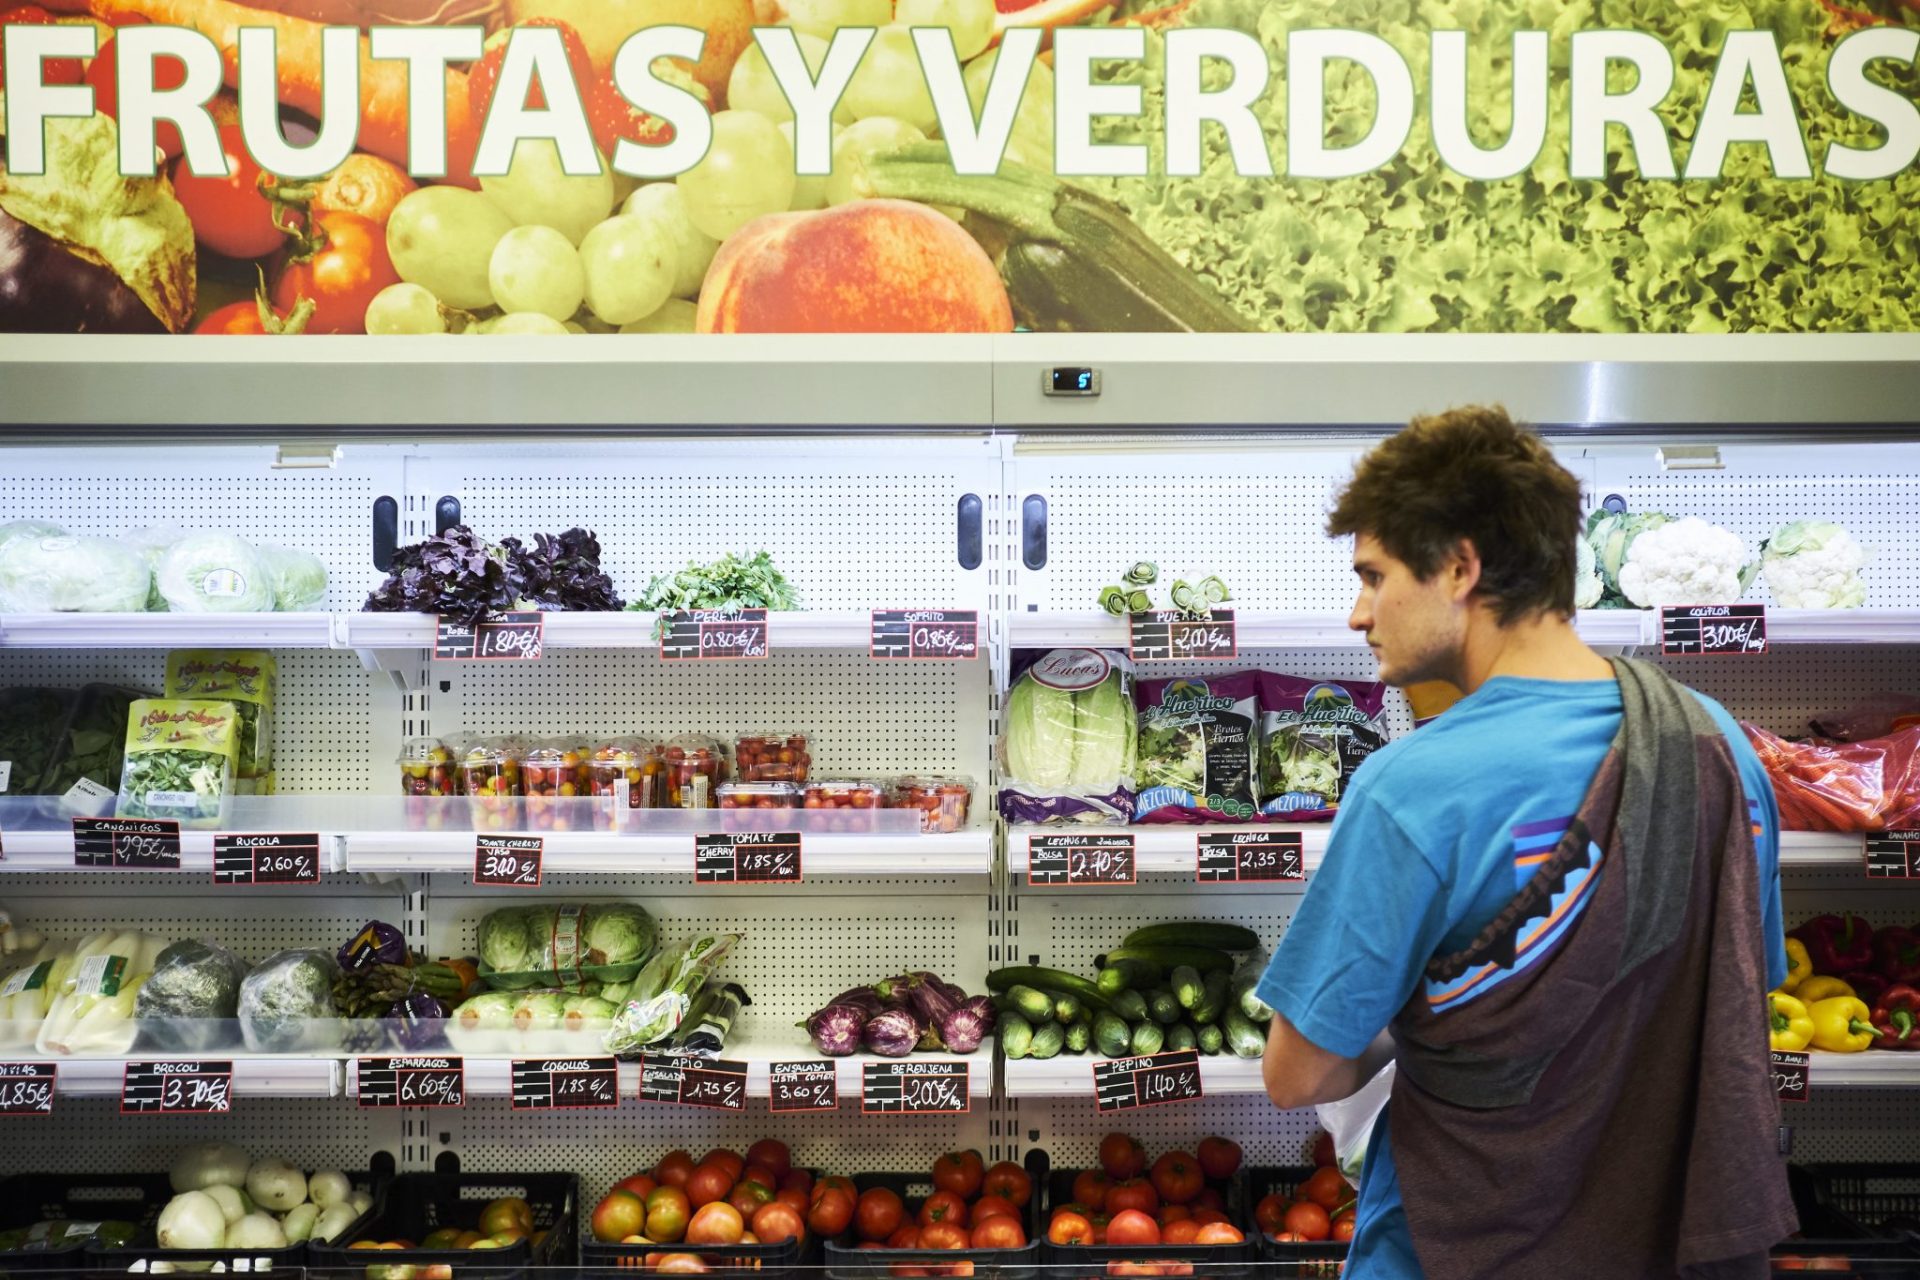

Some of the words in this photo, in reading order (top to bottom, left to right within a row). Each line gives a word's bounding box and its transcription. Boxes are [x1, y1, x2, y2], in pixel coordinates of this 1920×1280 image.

[4, 24, 714, 178] FRUTAS
[752, 26, 878, 177] Y
[909, 26, 1920, 182] VERDURAS
[1042, 657, 1100, 676] Lucas
[1136, 788, 1187, 814] MEZCLUM
[236, 837, 280, 847] RUCOLA
[727, 833, 775, 845] TOMATE
[1047, 835, 1088, 846] LECHUGA
[1232, 833, 1269, 844] LECHUGA
[699, 847, 735, 858] CHERRY
[1037, 850, 1064, 859] BOLSA
[1202, 848, 1228, 857] BOLSA
[542, 1060, 591, 1071] COGOLLOS
[671, 1056, 703, 1068] APIO
[775, 1062, 826, 1073] ENSALADA
[1112, 1057, 1153, 1074] PEPINO
[891, 1063, 953, 1074] BERENJENA
[642, 1069, 687, 1081] ENSALADA
[771, 1073, 798, 1083] LISTA
[805, 1072, 834, 1081] COMER
